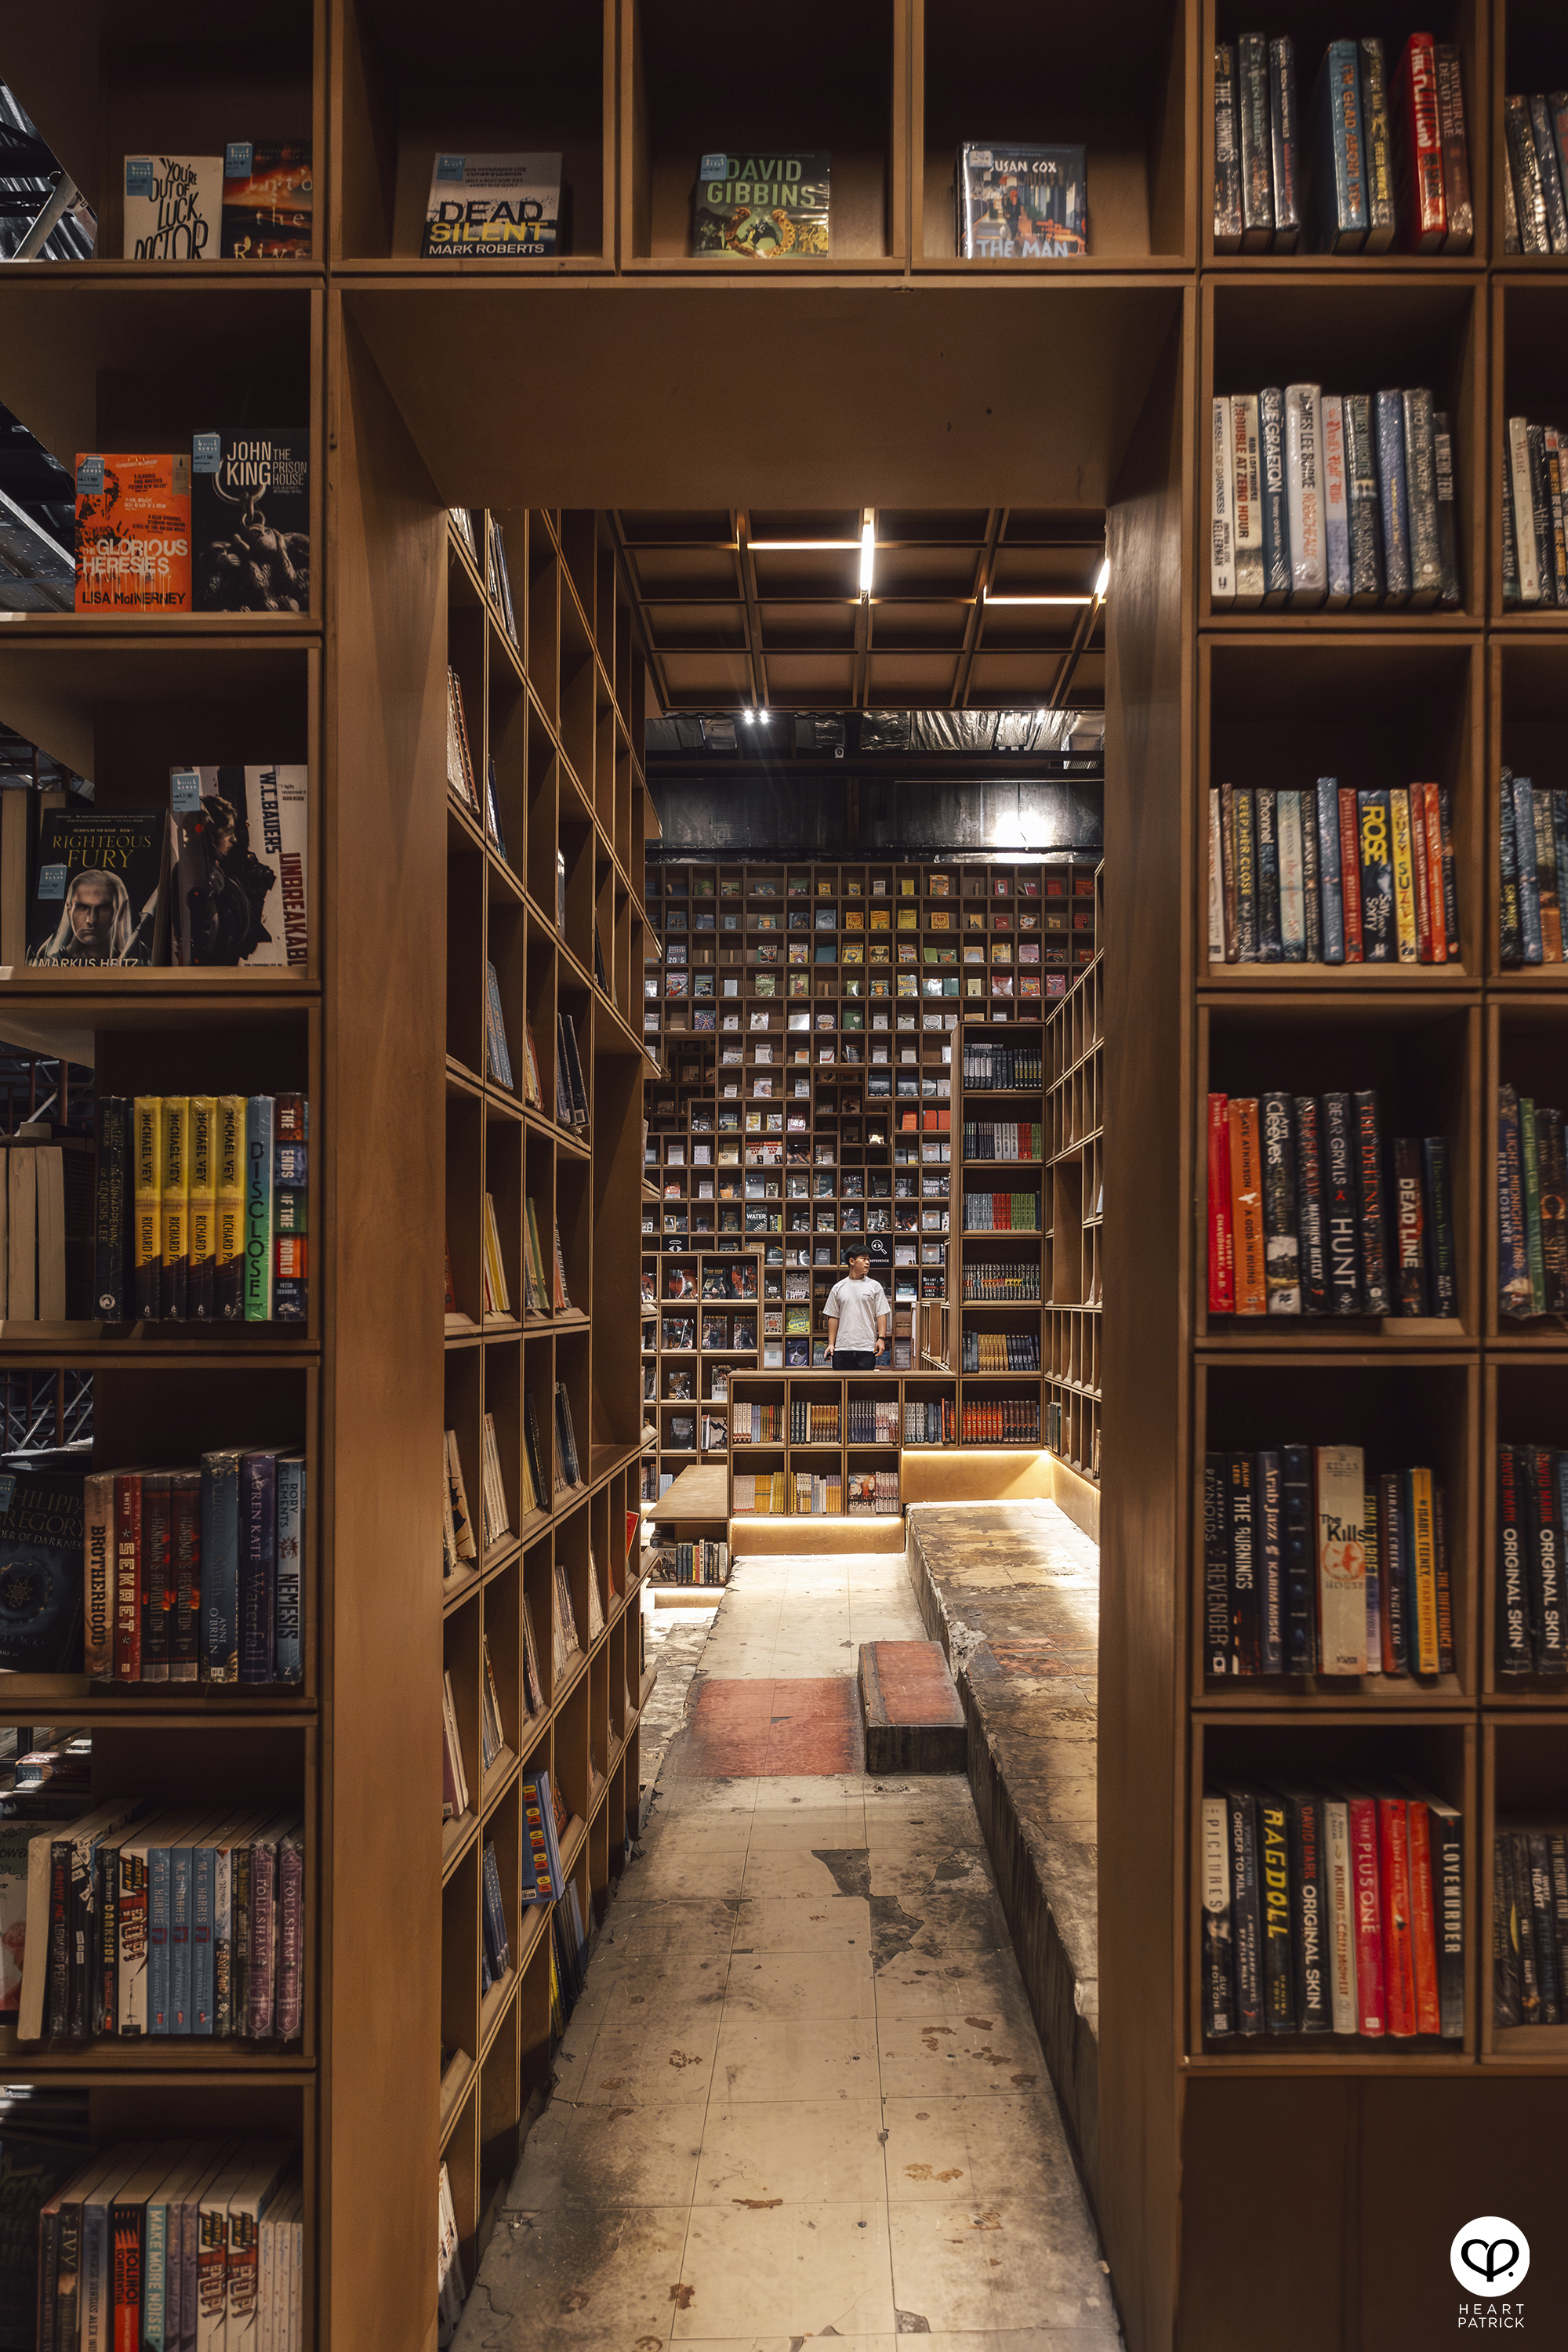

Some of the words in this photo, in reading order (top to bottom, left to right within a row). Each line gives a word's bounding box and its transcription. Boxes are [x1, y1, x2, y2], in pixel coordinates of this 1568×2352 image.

[1343, 92, 1356, 128] GLAD
[727, 158, 802, 181] DAVID
[1033, 162, 1057, 172] COX
[1345, 134, 1359, 178] ABOUT
[176, 183, 190, 197] OF
[707, 182, 815, 207] GIBBINS
[439, 201, 543, 224] DEAD
[429, 245, 474, 254] MARK
[476, 244, 544, 253] ROBERTS
[430, 222, 548, 242] SILENT
[977, 239, 1014, 257] THE
[1022, 240, 1069, 257] MAN
[1265, 396, 1278, 423] SUE
[1235, 404, 1249, 455] TROUBLE
[1301, 433, 1315, 451] LEE
[227, 441, 271, 461] JOHN
[273, 448, 291, 460] THE
[273, 461, 307, 474] PRISON
[1236, 457, 1247, 471] AT
[1267, 423, 1282, 493] GRAFTON
[227, 462, 271, 486] KING
[273, 474, 304, 485] HOUSE
[1237, 473, 1248, 502] ZERO
[1301, 453, 1316, 489] BURKE
[1215, 469, 1225, 514] DARKNESS
[1238, 505, 1249, 539] HOUR
[96, 539, 188, 557] GLORIOUS
[82, 557, 170, 575] HERESIES
[82, 592, 111, 604] LISA
[114, 592, 186, 604] McINERNEY
[1237, 796, 1250, 826] KEEP
[53, 835, 151, 851] RIGHTEOUS
[1239, 829, 1250, 855] HER
[1362, 806, 1387, 866] ROSE
[67, 850, 135, 869] FURY
[1240, 857, 1251, 895] CLOSE
[281, 1109, 295, 1129] THE
[1265, 1101, 1284, 1165] Cleeves
[1279, 1117, 1290, 1139] Ann
[1329, 1102, 1343, 1134] BEAR
[142, 1114, 152, 1159] MICHAEL
[142, 1161, 152, 1183] VEY
[169, 1160, 180, 1183] VEY
[196, 1160, 207, 1182] VEY
[224, 1160, 234, 1182] VEY
[281, 1149, 295, 1178] ENDS
[1330, 1138, 1346, 1185] GRYLLS
[281, 1207, 293, 1228] THE
[1399, 1178, 1417, 1224] DEAD
[1510, 1175, 1522, 1231] MIDNIGHT
[99, 1225, 107, 1243] LEE
[141, 1217, 153, 1252] RICHARD
[169, 1217, 180, 1251] RICHARD
[196, 1215, 206, 1251] RICHARD
[223, 1214, 234, 1251] RICHARD
[247, 1142, 265, 1298] DISCLOSE
[280, 1239, 293, 1275] WORLD
[1246, 1242, 1254, 1252] IN
[1330, 1218, 1356, 1289] HUNT
[1401, 1228, 1419, 1268] LINE
[1512, 1235, 1525, 1269] STARS
[1241, 1462, 1250, 1487] JULIAN
[1500, 1453, 1514, 1486] DAVID
[1536, 1454, 1551, 1487] DAVID
[251, 1463, 263, 1521] LAUREN
[279, 1467, 289, 1528] CLEMENTS
[289, 1483, 299, 1515] RORY
[1233, 1494, 1251, 1522] THE
[1388, 1483, 1399, 1533] MIRACLE
[1502, 1490, 1517, 1522] MARK
[1539, 1490, 1554, 1523] MARK
[1264, 1504, 1280, 1541] Jazz
[1319, 1514, 1341, 1524] The
[1327, 1524, 1367, 1542] Kills
[251, 1525, 264, 1561] KATE
[1235, 1527, 1253, 1590] BURNINGS
[1389, 1537, 1399, 1570] CREEK
[1267, 1561, 1279, 1602] KARIM
[1437, 1571, 1448, 1588] THE
[1503, 1529, 1521, 1605] ORIGINAL
[1540, 1529, 1557, 1606] ORIGINAL
[90, 1525, 106, 1646] BROTHERHOOD
[118, 1542, 135, 1632] SEKRET
[245, 1571, 266, 1663] Waterfall
[278, 1573, 299, 1640] NEMESIS
[1207, 1563, 1229, 1646] REVENGER
[1438, 1591, 1451, 1649] DIFFERENCE
[209, 1607, 219, 1654] O'BRIEN
[218, 1619, 227, 1644] ANNE
[1391, 1623, 1400, 1646] KIM
[1507, 1609, 1524, 1649] SKIN
[1544, 1610, 1560, 1650] SKIN
[1233, 1811, 1243, 1853] ORDER
[1301, 1807, 1315, 1841] DAVID
[1234, 1855, 1244, 1871] TO
[1263, 1808, 1289, 1940] RAGDOLL
[1303, 1845, 1316, 1879] MARK
[1359, 1842, 1374, 1887] PLUS
[1554, 1858, 1567, 1896] HIGHWAY
[1236, 1874, 1245, 1900] KILL
[1443, 1843, 1461, 1953] LOVEMURDER
[1531, 1868, 1544, 1909] HEART
[197, 1887, 208, 1923] HARRIS
[255, 1879, 267, 1956] FOULSHAM
[284, 1880, 296, 1958] FOULSHAM
[104, 1904, 114, 1963] DARKSIDE
[1302, 1885, 1319, 1965] ORIGINAL
[1305, 1968, 1321, 2010] SKIN
[148, 2210, 165, 2249] MAKE
[62, 2228, 78, 2267] IVY
[148, 2252, 165, 2289] MORE
